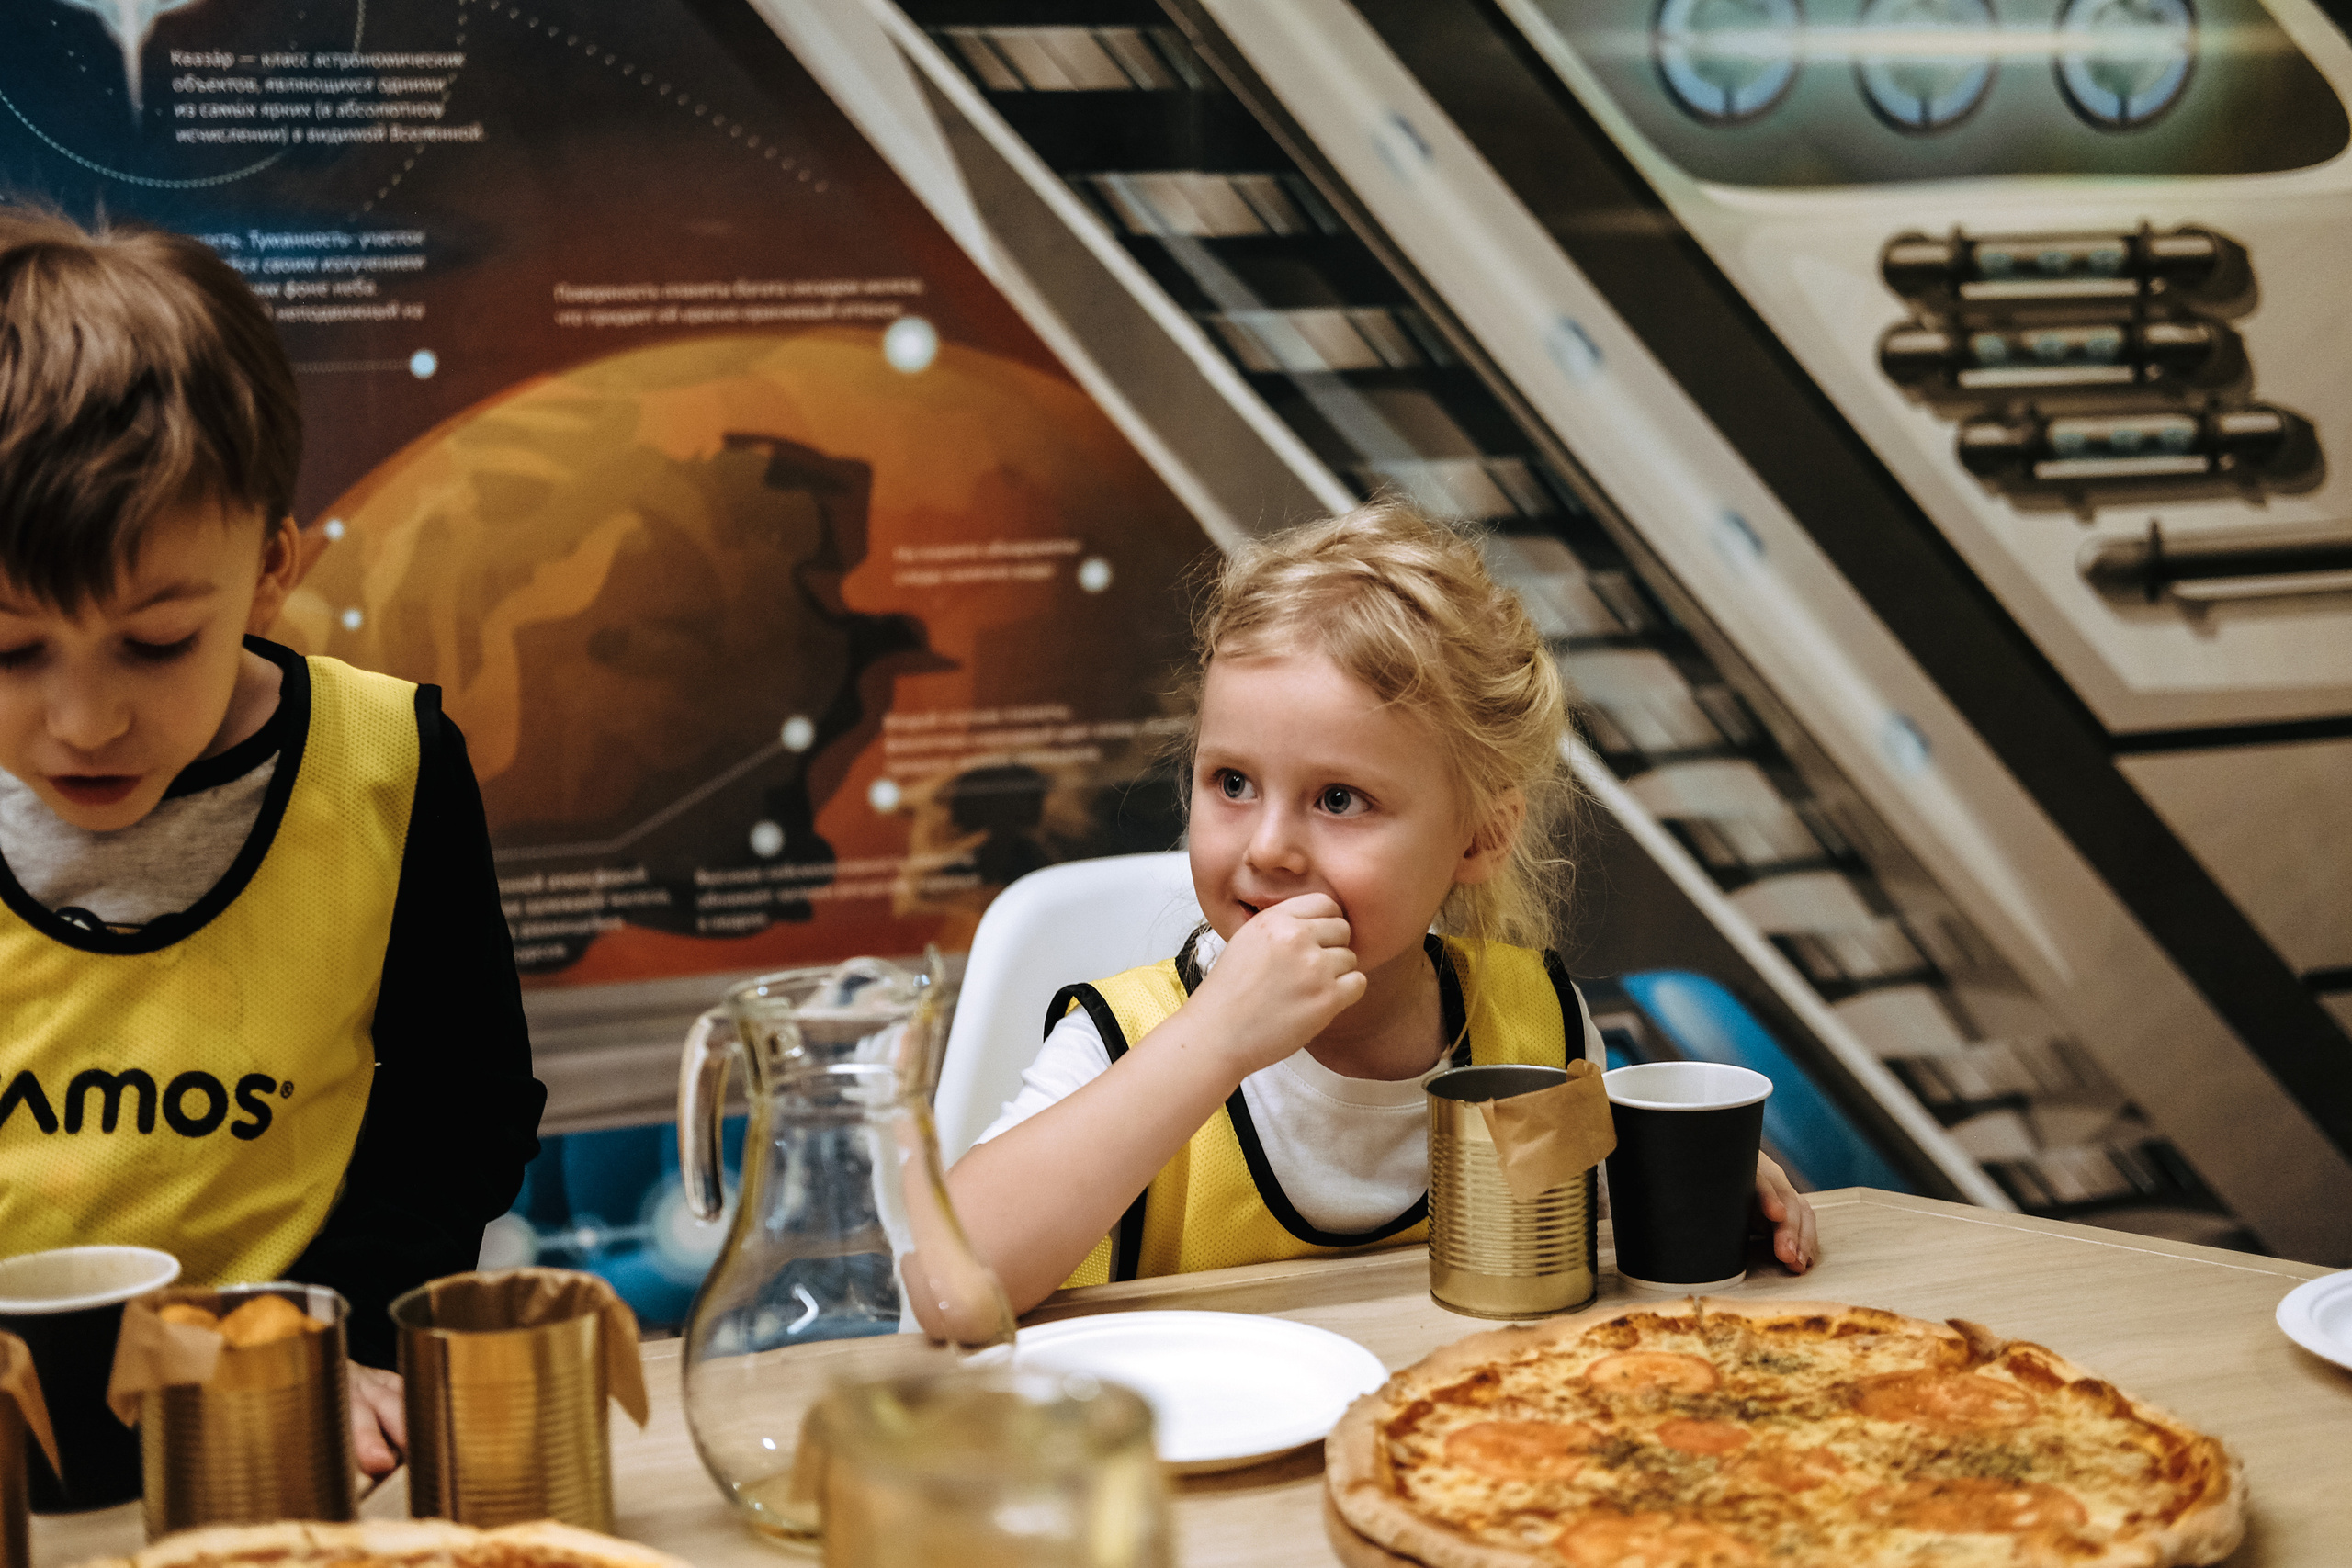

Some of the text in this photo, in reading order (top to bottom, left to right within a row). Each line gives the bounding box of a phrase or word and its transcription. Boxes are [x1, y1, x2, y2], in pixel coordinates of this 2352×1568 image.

[174, 103, 197, 118] из
[359, 231, 426, 251] участок
[262, 256, 317, 275] своим
[284, 279, 330, 300] фоне
